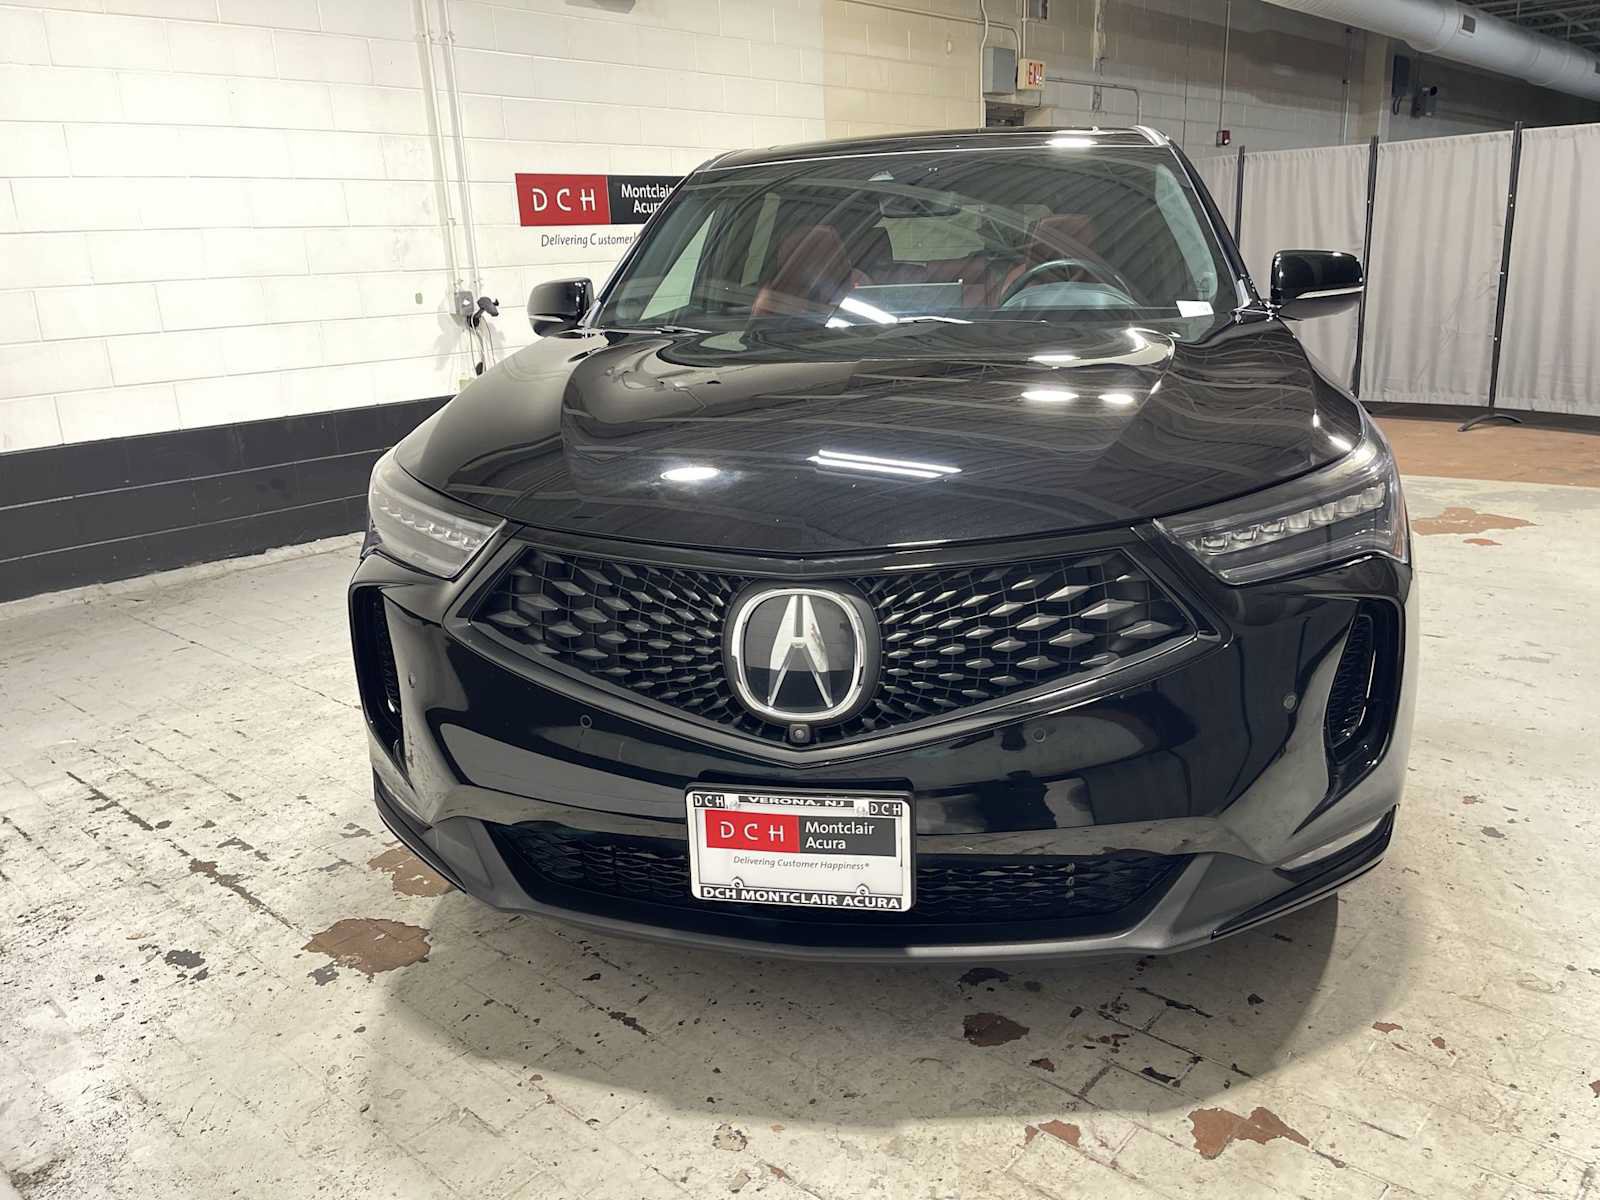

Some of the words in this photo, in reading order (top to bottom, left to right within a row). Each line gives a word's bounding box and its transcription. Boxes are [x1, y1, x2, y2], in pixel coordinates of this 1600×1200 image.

[532, 188, 596, 212] DCH
[633, 199, 662, 213] Acur
[541, 233, 588, 248] Delivering
[694, 795, 724, 807] DCH
[870, 803, 902, 815] DCH
[720, 821, 784, 842] DCH
[805, 821, 875, 835] Montclair
[805, 836, 847, 849] Acura
[733, 855, 775, 868] Delivering
[777, 859, 819, 868] Customer
[703, 887, 737, 899] DCH
[741, 889, 838, 905] MONTCLAIR
[842, 895, 900, 908] ACURA
